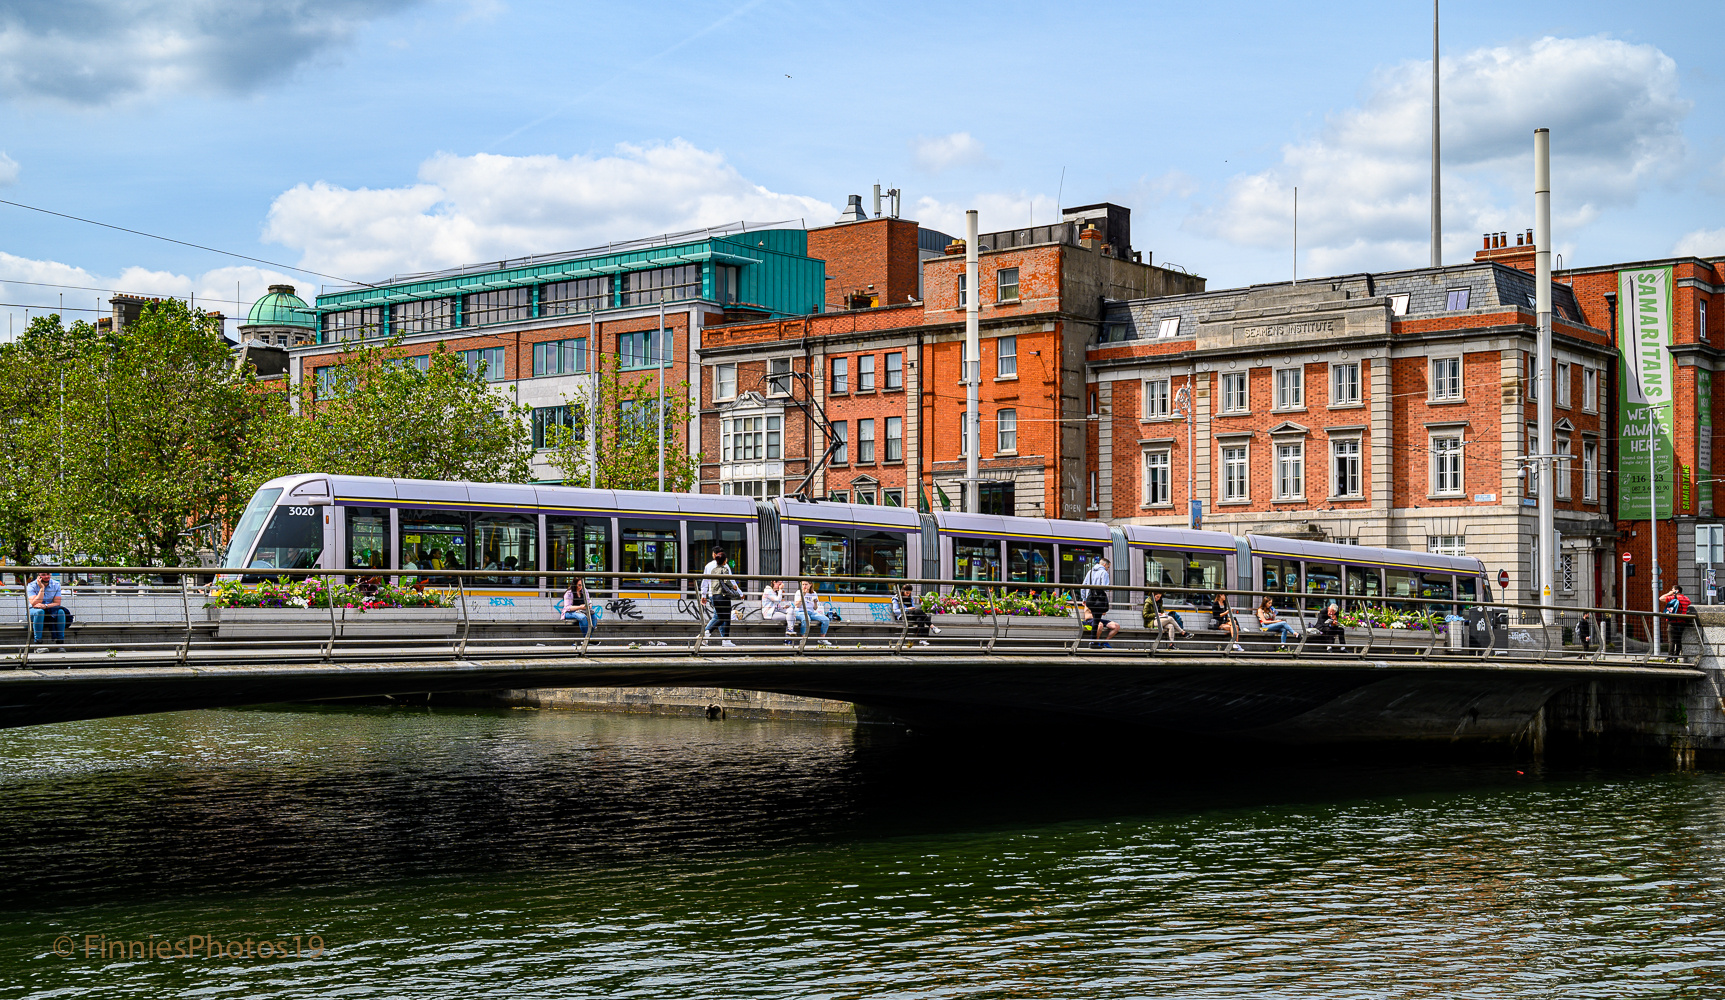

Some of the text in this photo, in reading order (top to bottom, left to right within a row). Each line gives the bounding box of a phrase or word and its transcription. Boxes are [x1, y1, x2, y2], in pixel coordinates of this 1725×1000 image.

[1244, 321, 1334, 338] SEAMENS INSTITUTE
[1637, 273, 1663, 397] SAMARITANS
[1632, 475, 1646, 483] 116
[1682, 464, 1690, 510] SAMARITANS
[288, 506, 315, 517] 3020
[1064, 503, 1081, 513] OPEN
